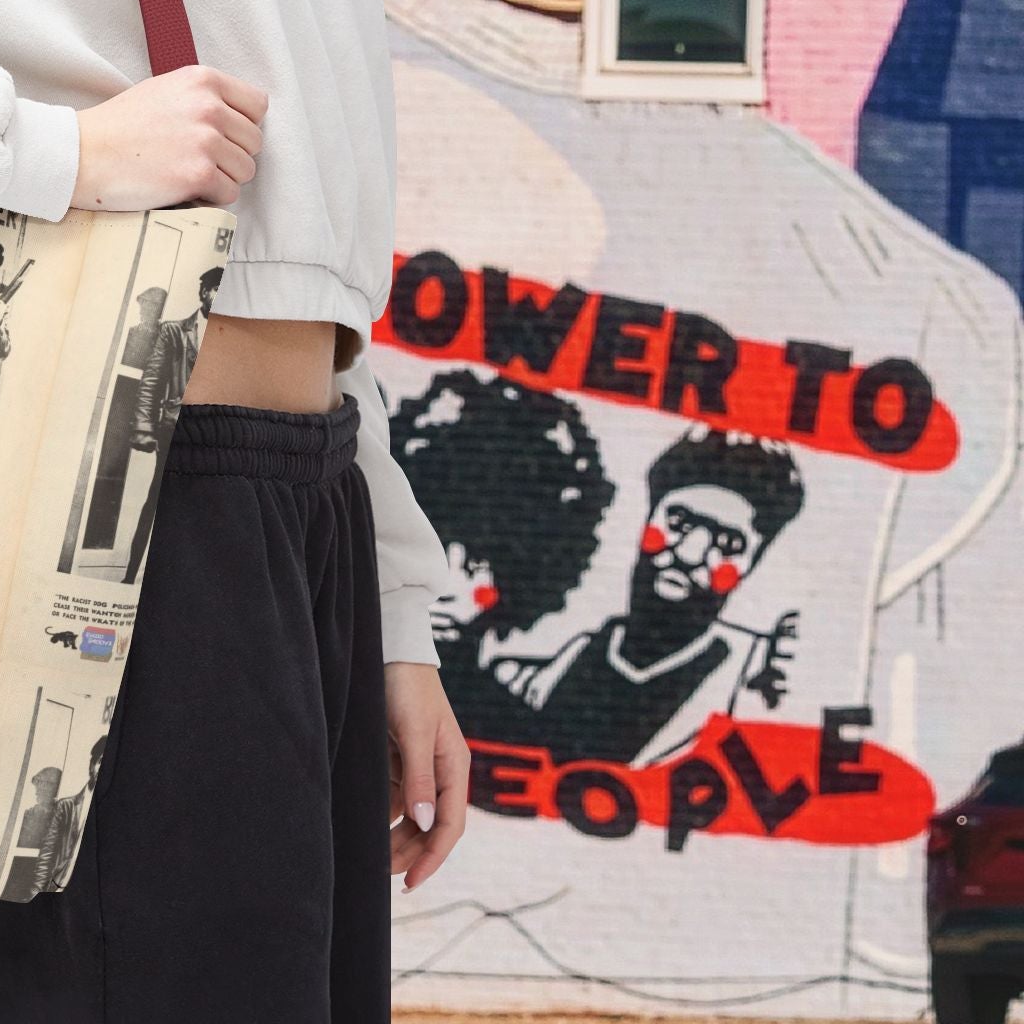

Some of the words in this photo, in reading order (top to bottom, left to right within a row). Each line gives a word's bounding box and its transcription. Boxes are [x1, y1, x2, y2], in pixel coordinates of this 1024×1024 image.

[389, 250, 741, 416] OWER
[784, 338, 935, 455] TO
[72, 597, 91, 605] RACIST
[53, 602, 70, 610] CEASE
